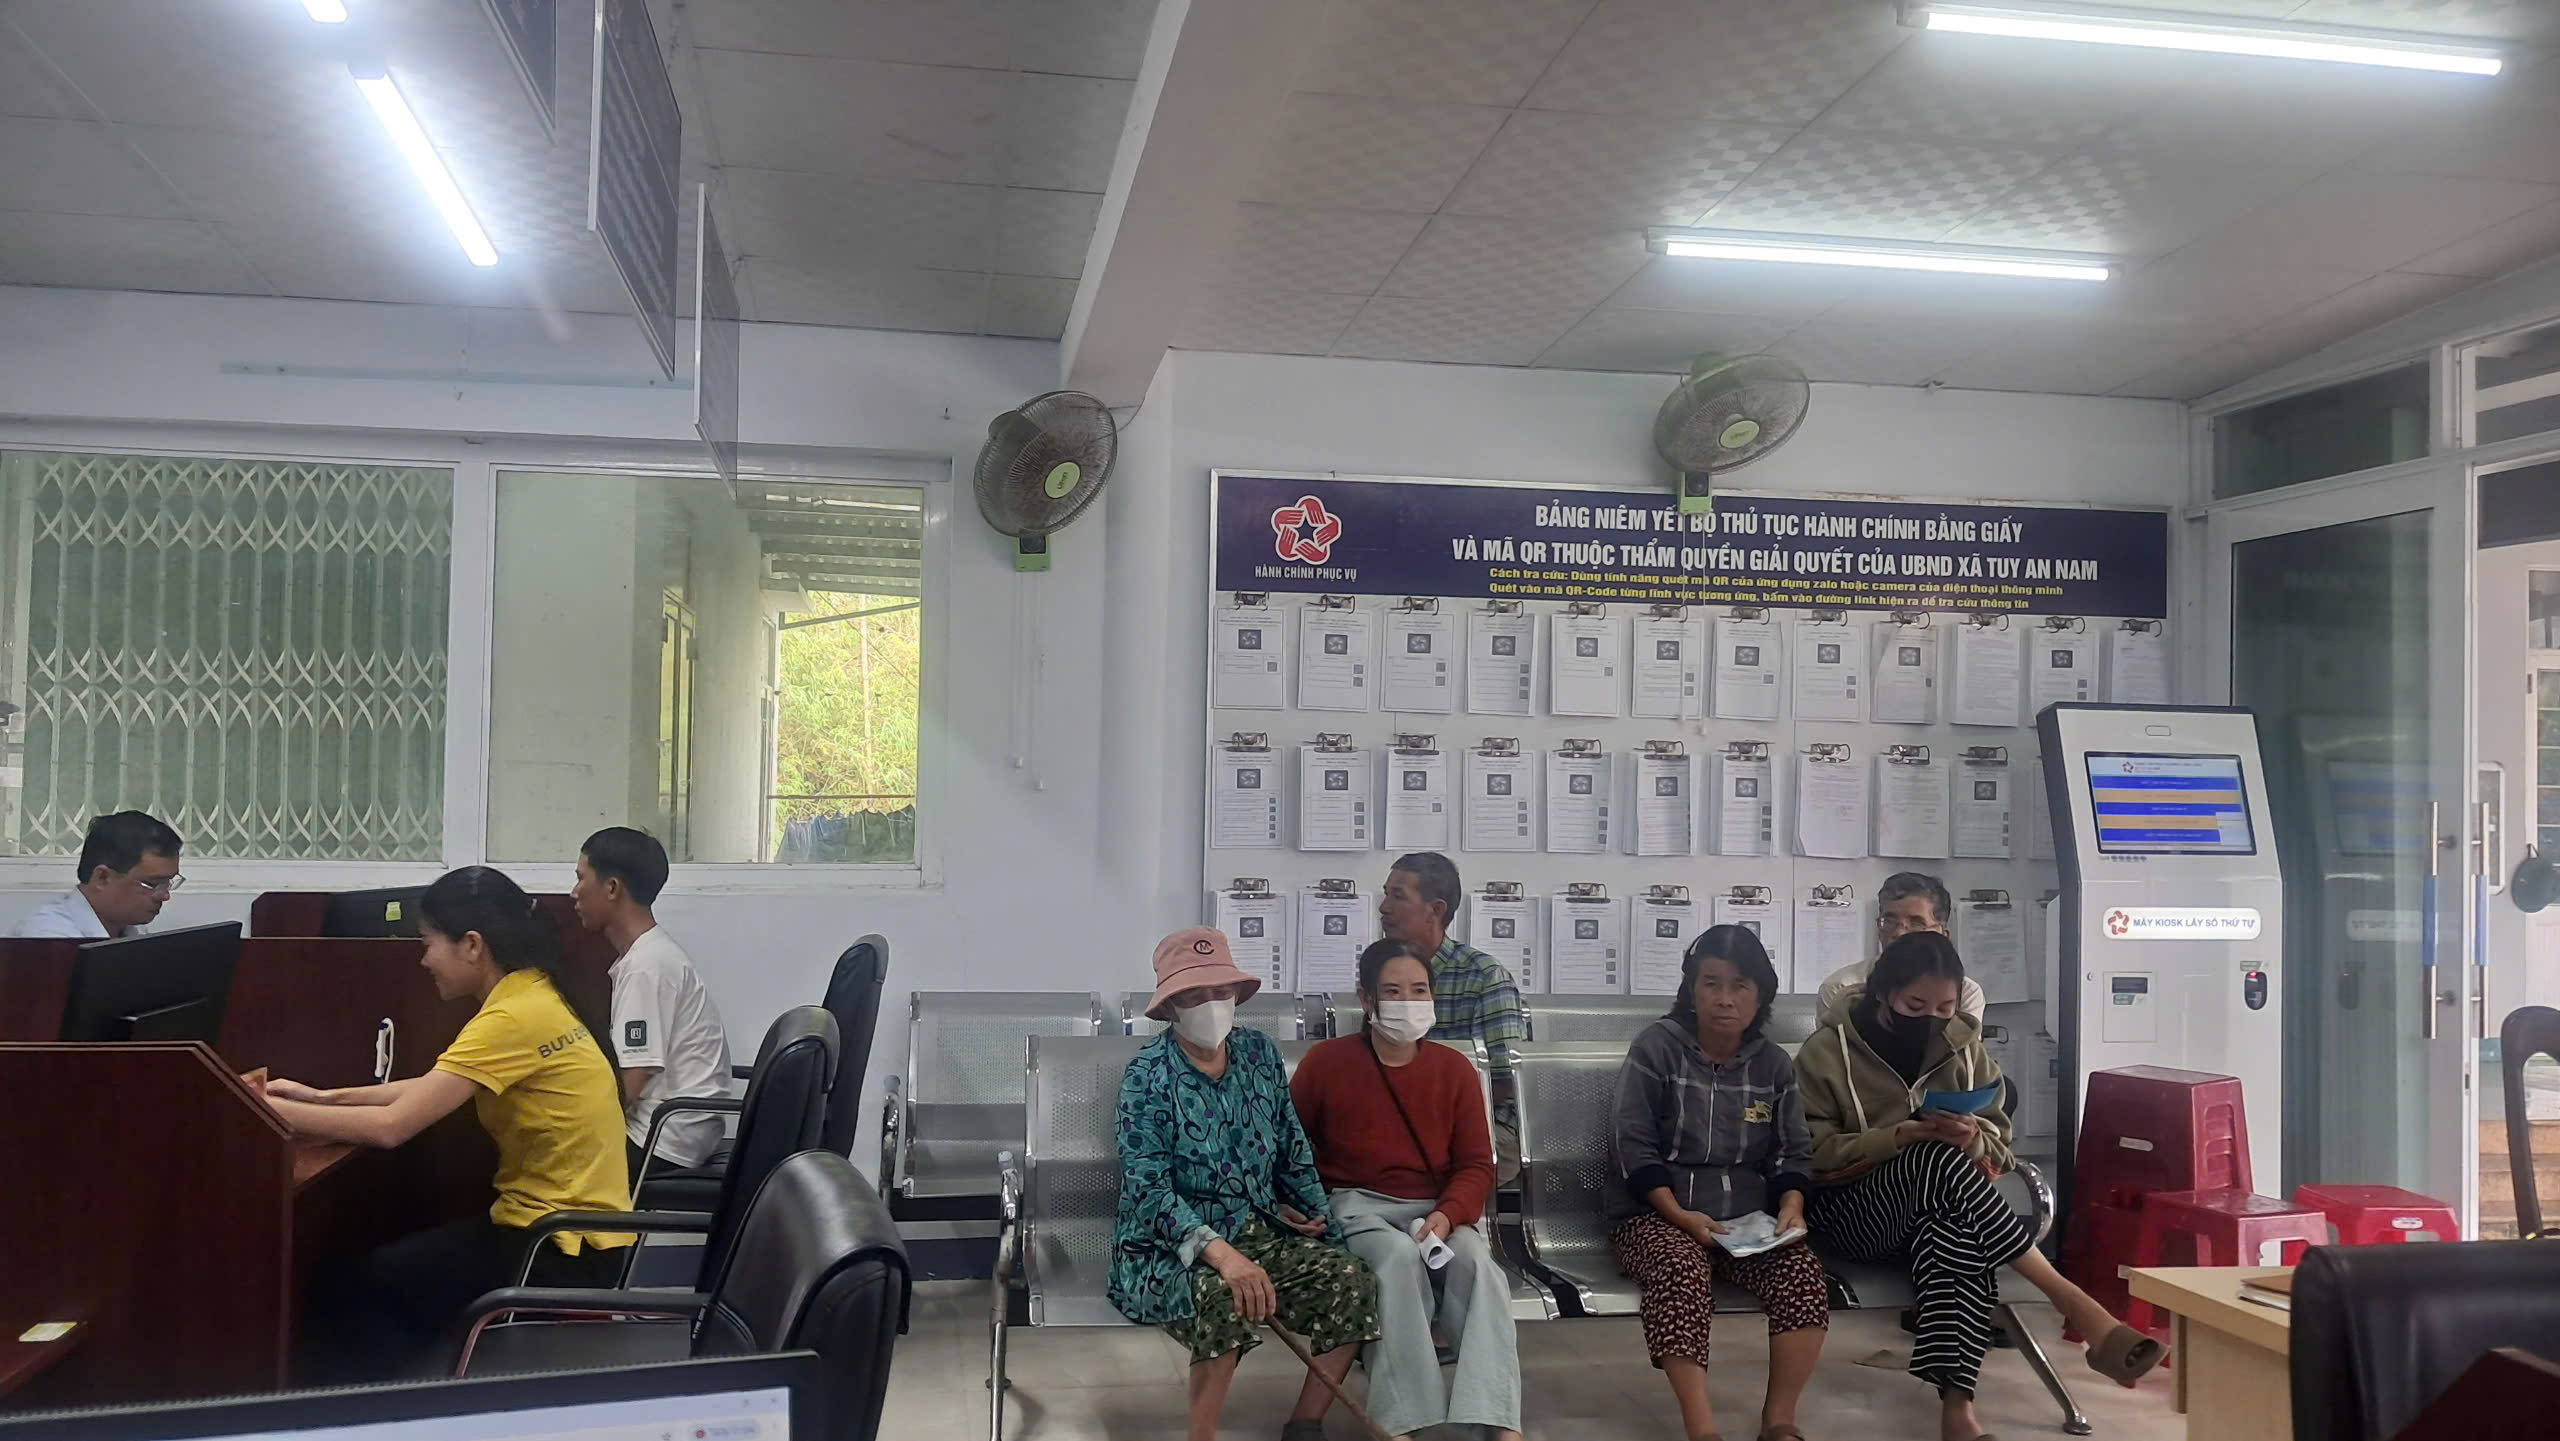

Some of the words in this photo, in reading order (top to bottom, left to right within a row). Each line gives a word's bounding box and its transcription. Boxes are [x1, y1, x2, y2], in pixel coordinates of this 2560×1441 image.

[1535, 499, 1589, 529] BẢNG
[1595, 504, 1646, 531] NIÊM
[1651, 503, 1685, 533] YẾT
[1690, 510, 1717, 538] BỘ
[1721, 506, 1758, 535] THỦ
[1763, 514, 1799, 540] TỤC
[1804, 512, 1857, 538] HÀNH
[1862, 514, 1920, 540] CHÍNH
[1925, 512, 1976, 542] BẰNG
[1981, 515, 2023, 543] GIẤY
[1452, 535, 1478, 561] VÀ
[1483, 537, 1515, 563] MÃ
[1520, 540, 1547, 566] QR
[1551, 539, 1615, 570] THUỘC
[1620, 538, 1676, 568] THẨM
[1681, 541, 1745, 572] QUYỀN
[1750, 543, 1789, 573] GIẢI
[1793, 546, 1853, 575] QUYẾT
[1858, 547, 1897, 576] CỦA
[1901, 554, 1953, 577] UBND
[1957, 552, 1983, 578] XÃ
[1986, 557, 2021, 579] TUY
[2025, 558, 2051, 580] AN
[2055, 559, 2098, 581] NAM
[1255, 563, 1282, 578] HÀNH
[1283, 564, 1314, 579] CHÍNH
[1316, 567, 1342, 582] PHỤC
[1344, 568, 1357, 583] VỤ
[1489, 567, 1520, 578] Cách
[1523, 569, 1540, 579] tra
[1542, 570, 1569, 580] cứu:
[1571, 570, 1602, 582] Dùng
[1604, 572, 1627, 582] tính
[1629, 573, 1660, 584] năng
[1662, 574, 1689, 585] quét
[1712, 576, 1729, 586] QR
[1731, 576, 1754, 586] của
[1781, 578, 1811, 590] dụng
[1812, 580, 1838, 589] zalo
[1840, 580, 1869, 591] hoặc
[1872, 582, 1916, 591] camera
[1919, 582, 1940, 592] của
[1970, 584, 1998, 595] thoại
[2001, 584, 2032, 595] thông
[2035, 586, 2063, 595] minh
[1489, 583, 1517, 593] Quét
[1519, 584, 1541, 594] vào
[1544, 585, 1563, 595] mã
[1565, 586, 1617, 596] QR-Code
[1791, 593, 1813, 603] vào
[1854, 595, 1877, 605] link
[1879, 596, 1904, 607] hiện
[1907, 598, 1919, 606] ra
[1938, 597, 1954, 607] tra
[1956, 598, 1978, 608] cứu
[1980, 598, 2012, 609] thông
[2014, 600, 2029, 609] tin
[2155, 919, 2183, 927] KIOSK
